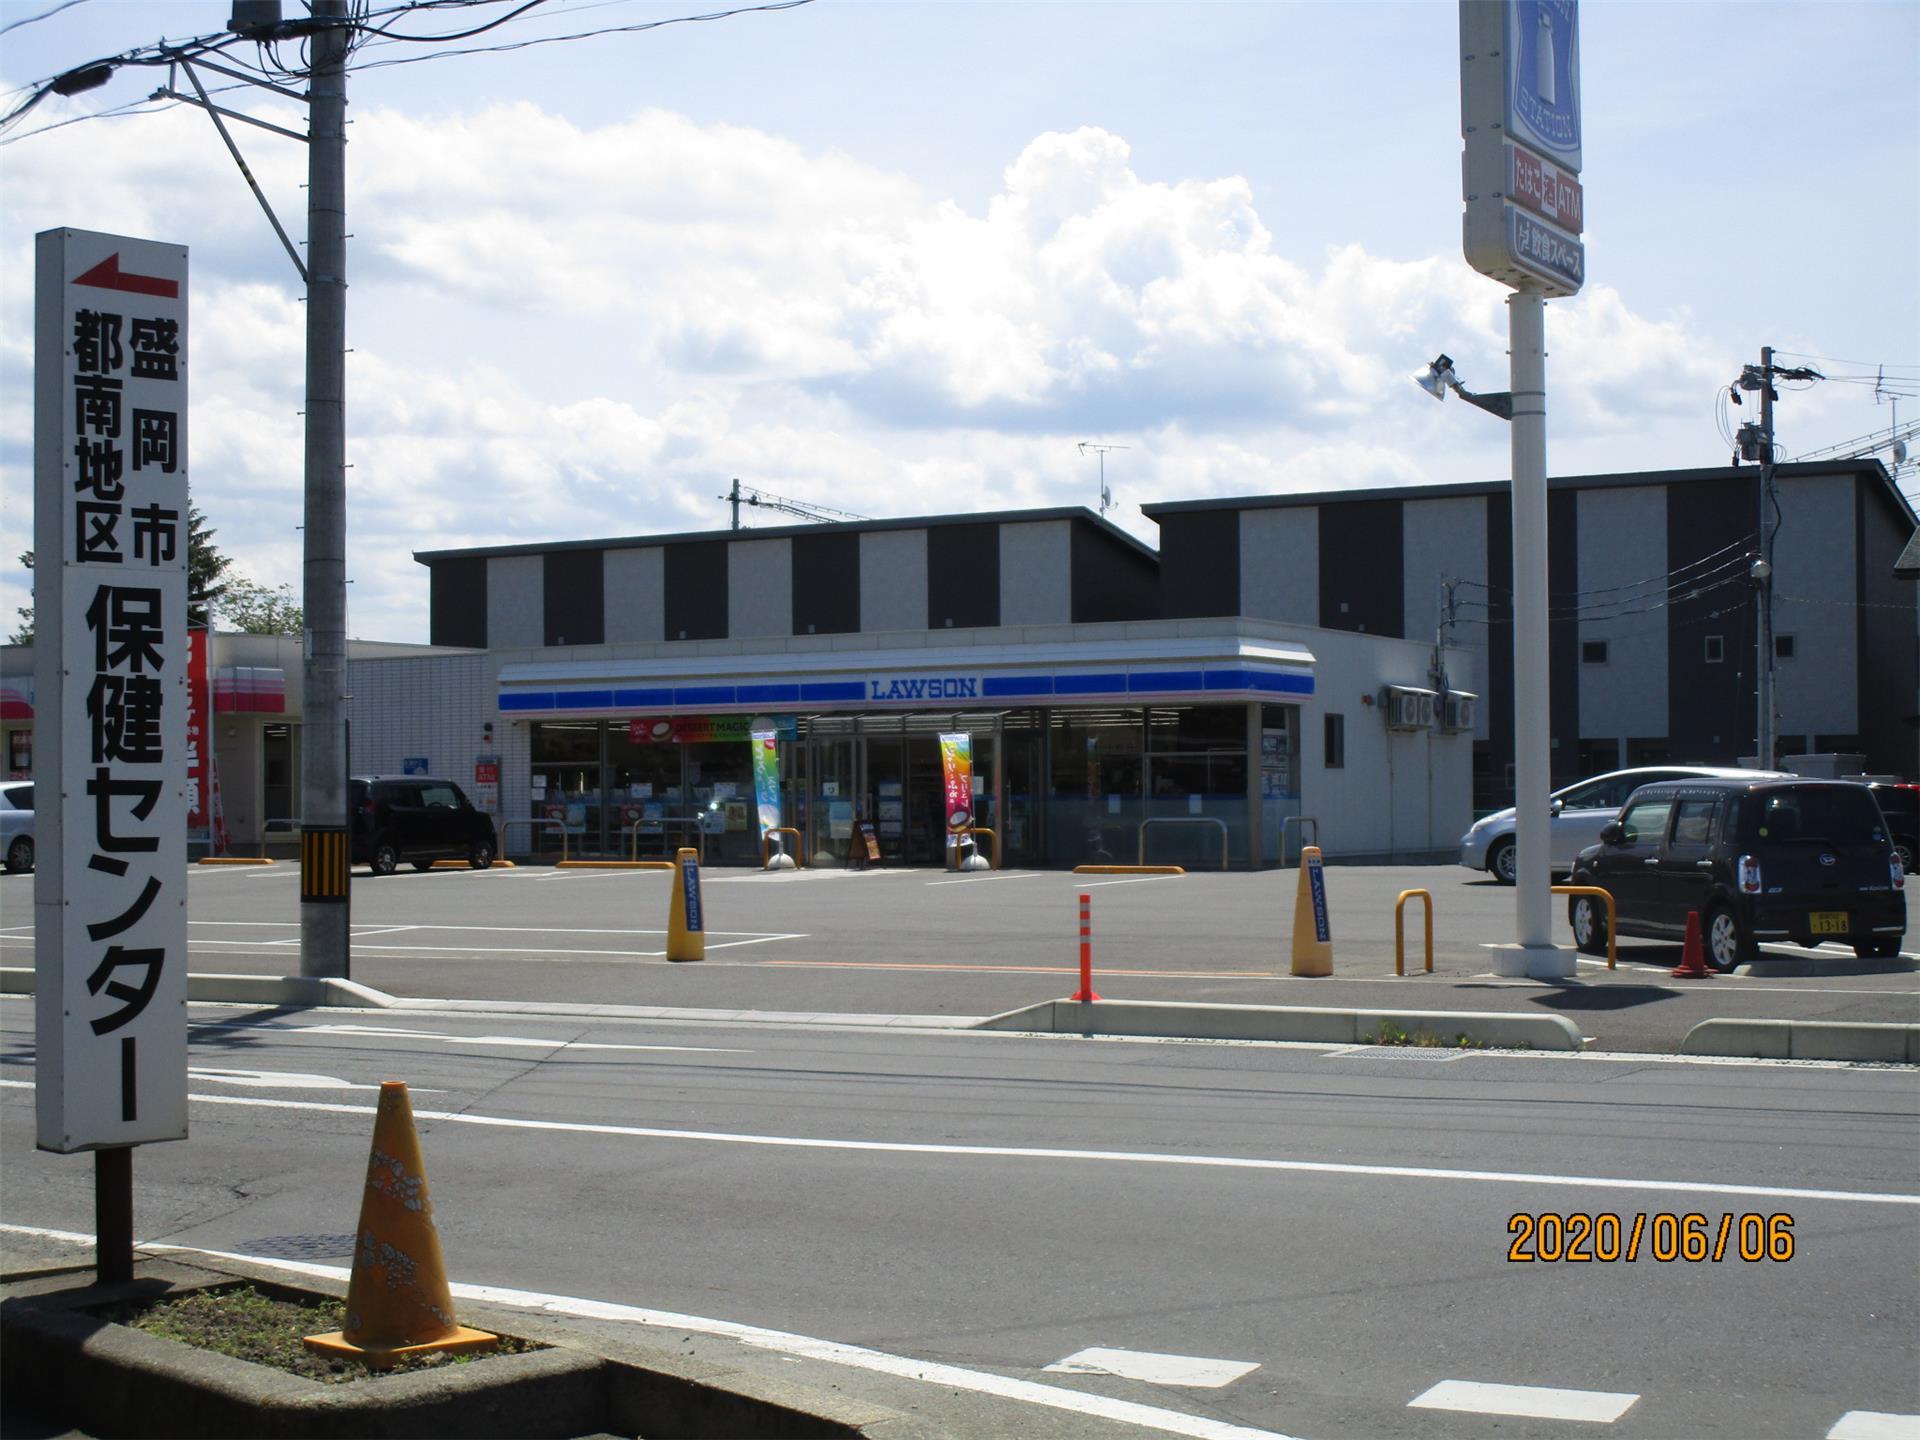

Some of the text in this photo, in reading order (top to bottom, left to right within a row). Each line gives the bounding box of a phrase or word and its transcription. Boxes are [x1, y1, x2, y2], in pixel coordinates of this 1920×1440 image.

[1519, 85, 1573, 139] STATION
[1558, 183, 1581, 222] ATM
[1531, 226, 1581, 276] 飲食スペース
[73, 308, 124, 564] 都南地区
[129, 317, 180, 567] 盛岡市
[871, 677, 977, 700] LAWSON
[86, 585, 165, 1122] 保健センター
